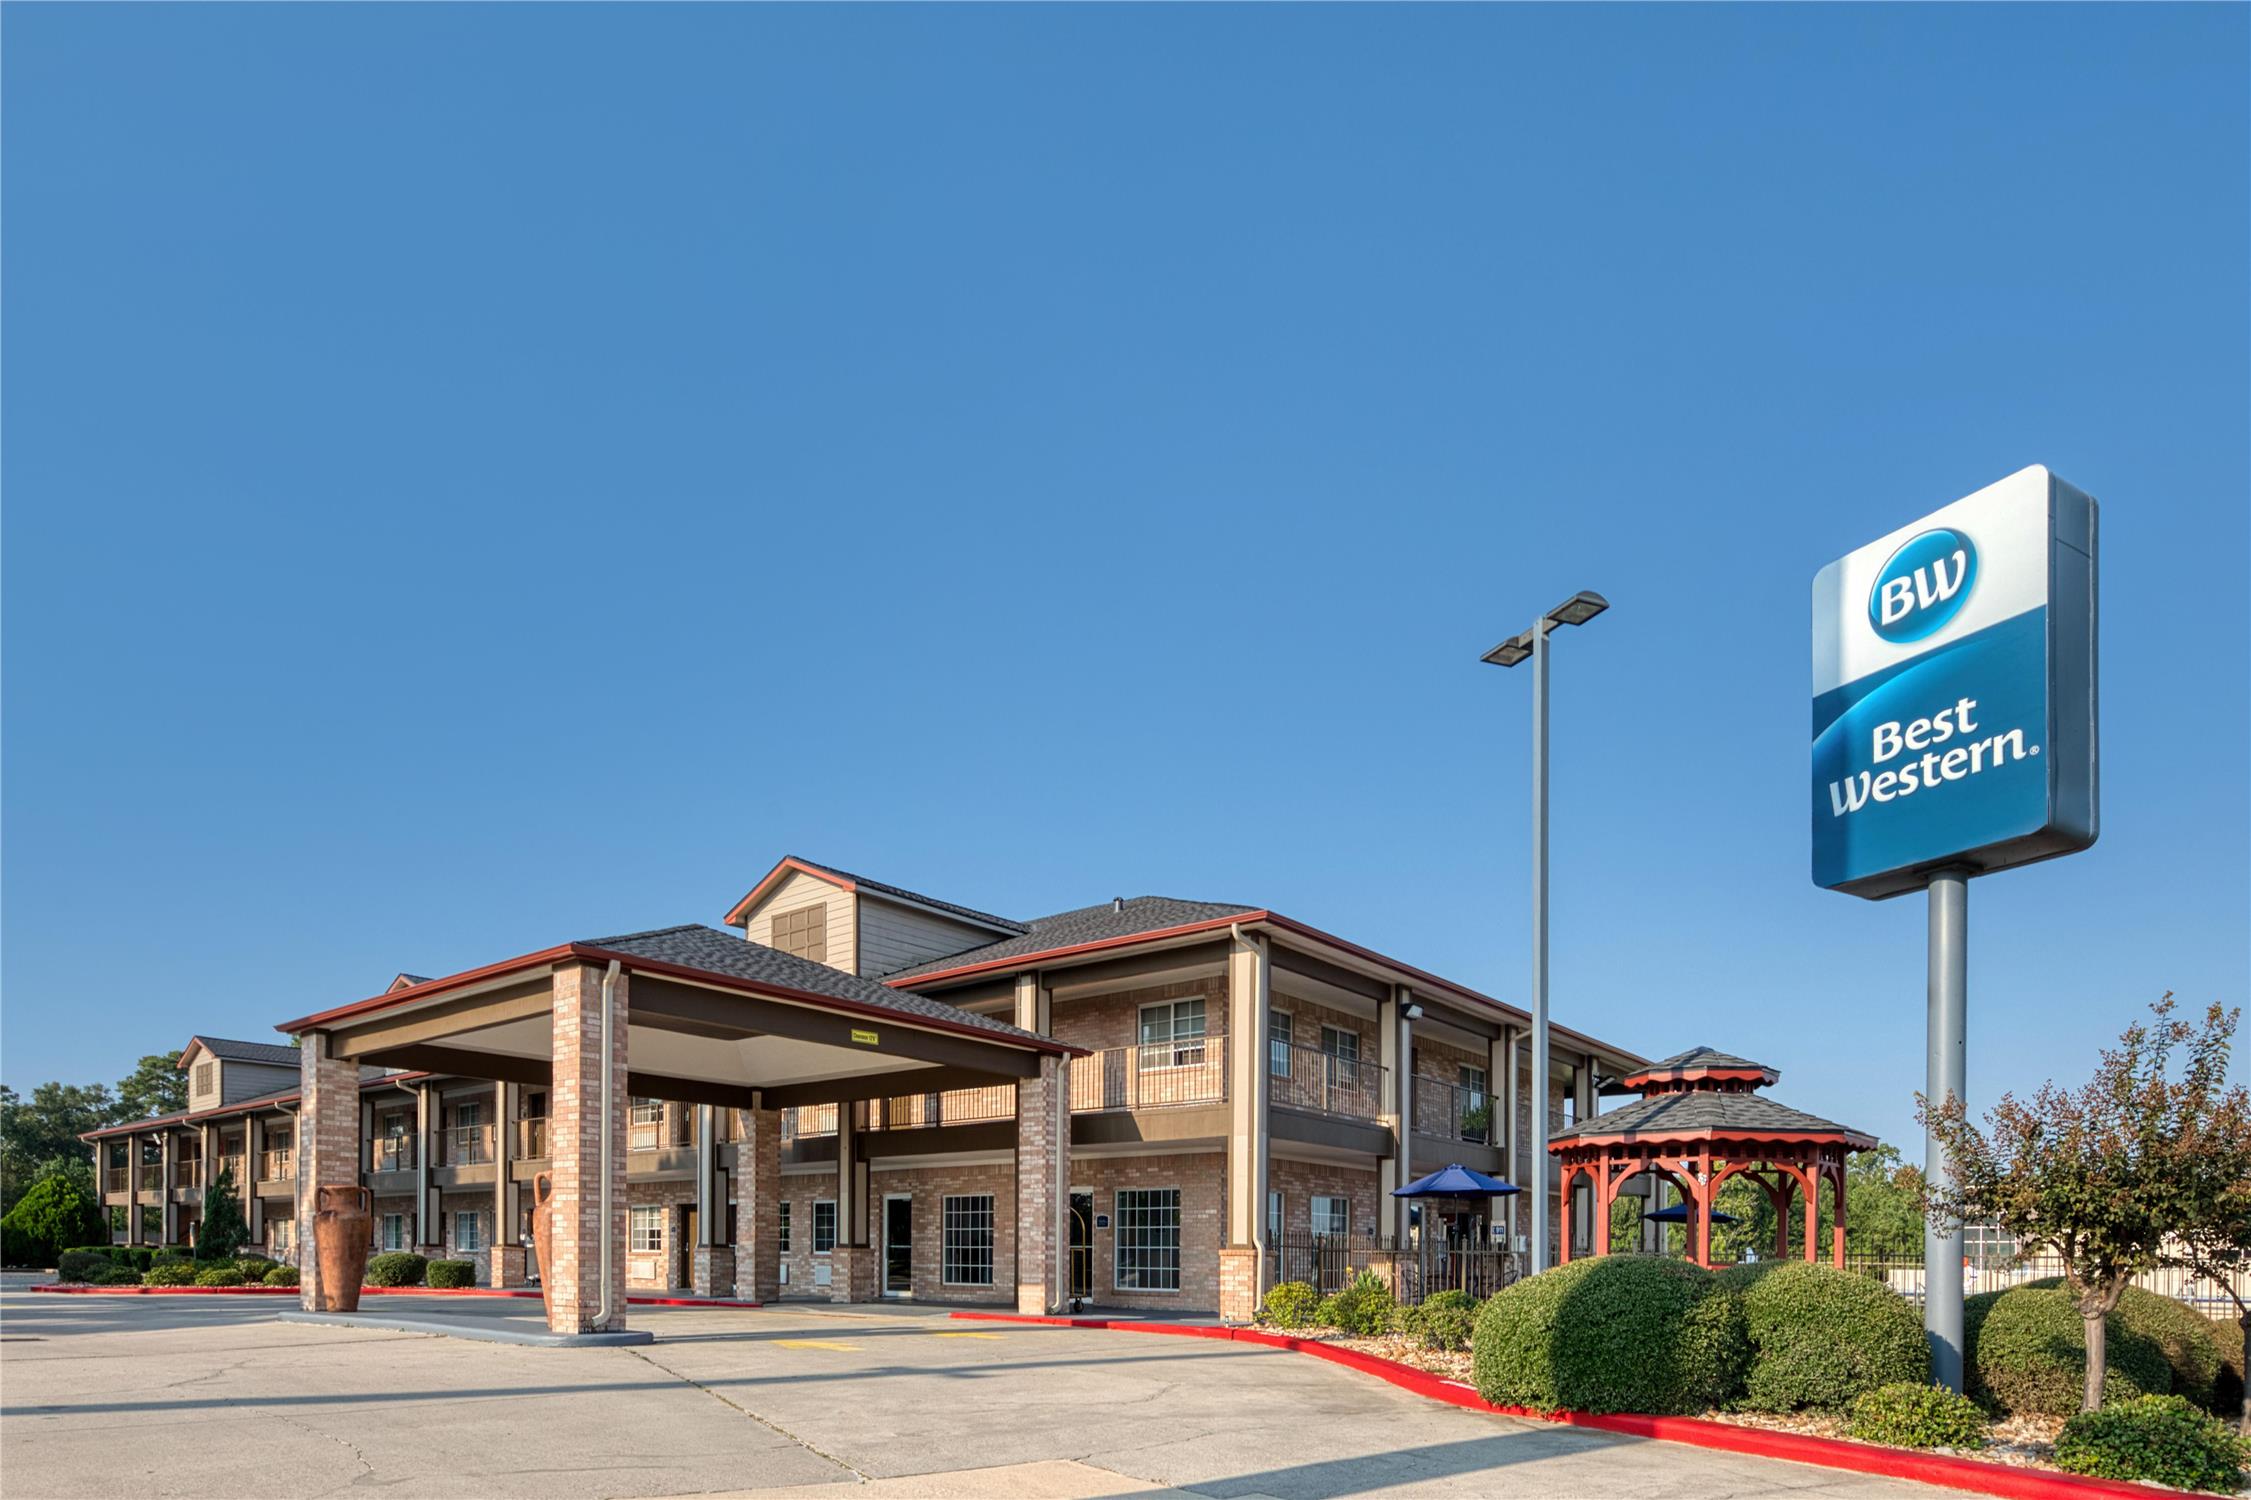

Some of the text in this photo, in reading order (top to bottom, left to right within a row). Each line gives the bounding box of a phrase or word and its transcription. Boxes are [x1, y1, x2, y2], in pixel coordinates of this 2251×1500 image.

[1881, 549, 1966, 626] BW
[1872, 697, 1978, 764] Best
[1829, 728, 2027, 818] Western
